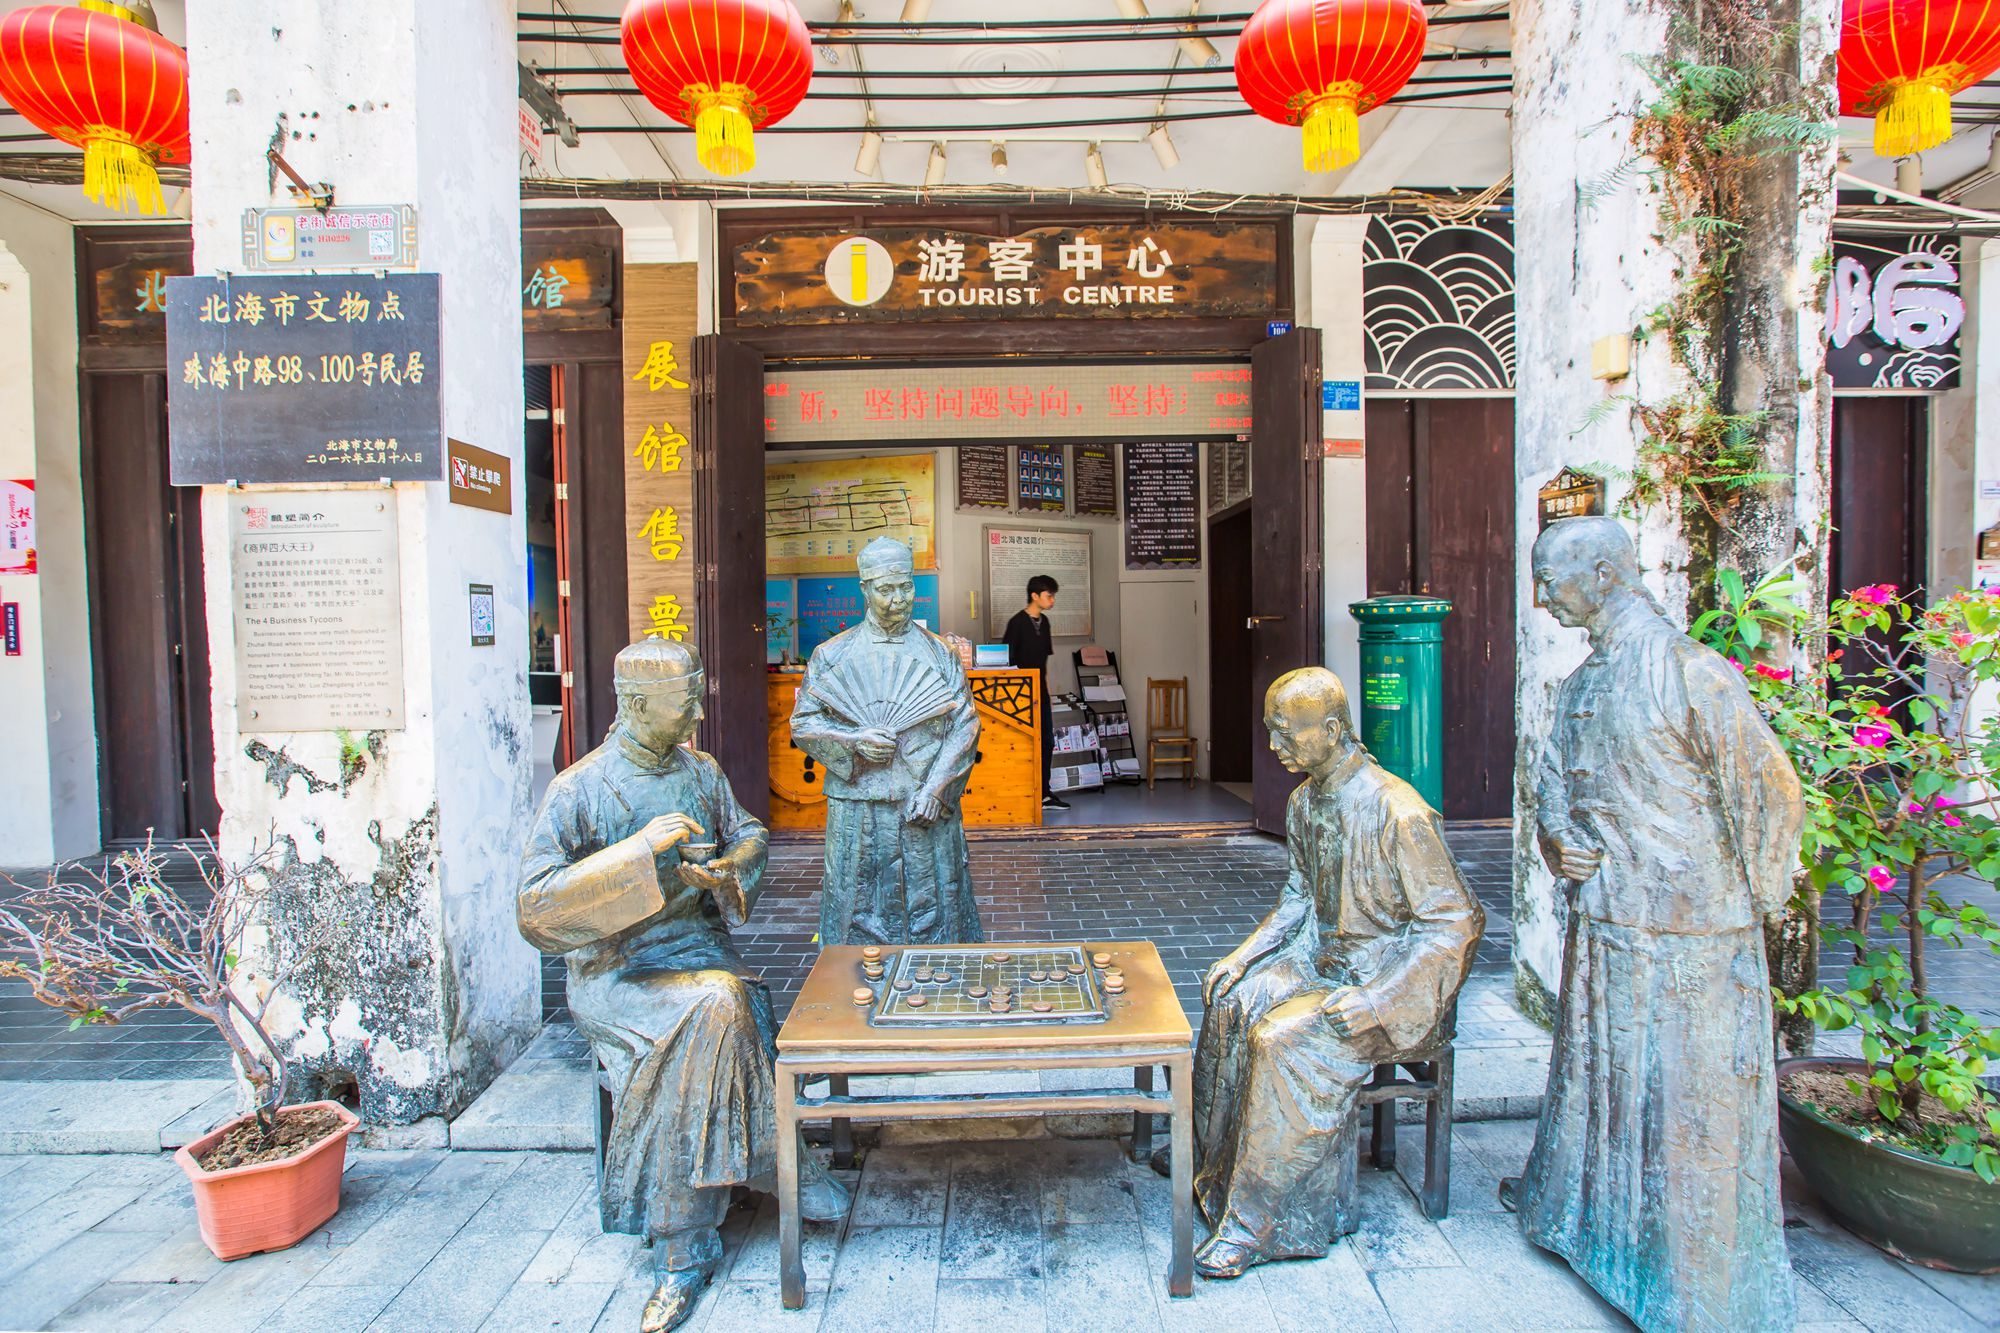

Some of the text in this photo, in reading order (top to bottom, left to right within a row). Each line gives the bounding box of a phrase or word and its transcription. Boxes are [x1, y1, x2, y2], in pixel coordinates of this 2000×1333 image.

[918, 237, 1174, 282] 游客中心
[523, 265, 570, 310] 馆
[918, 285, 1174, 306] TOURIST CENTRE
[199, 290, 406, 326] 北海市文物点
[183, 350, 426, 391] 珠海中路98、100号民居
[326, 438, 399, 452] 北海市文物局
[631, 340, 691, 642] 展馆售票
[246, 617, 261, 625] The
[270, 616, 307, 625] Business
[309, 615, 343, 625] Tycoons
